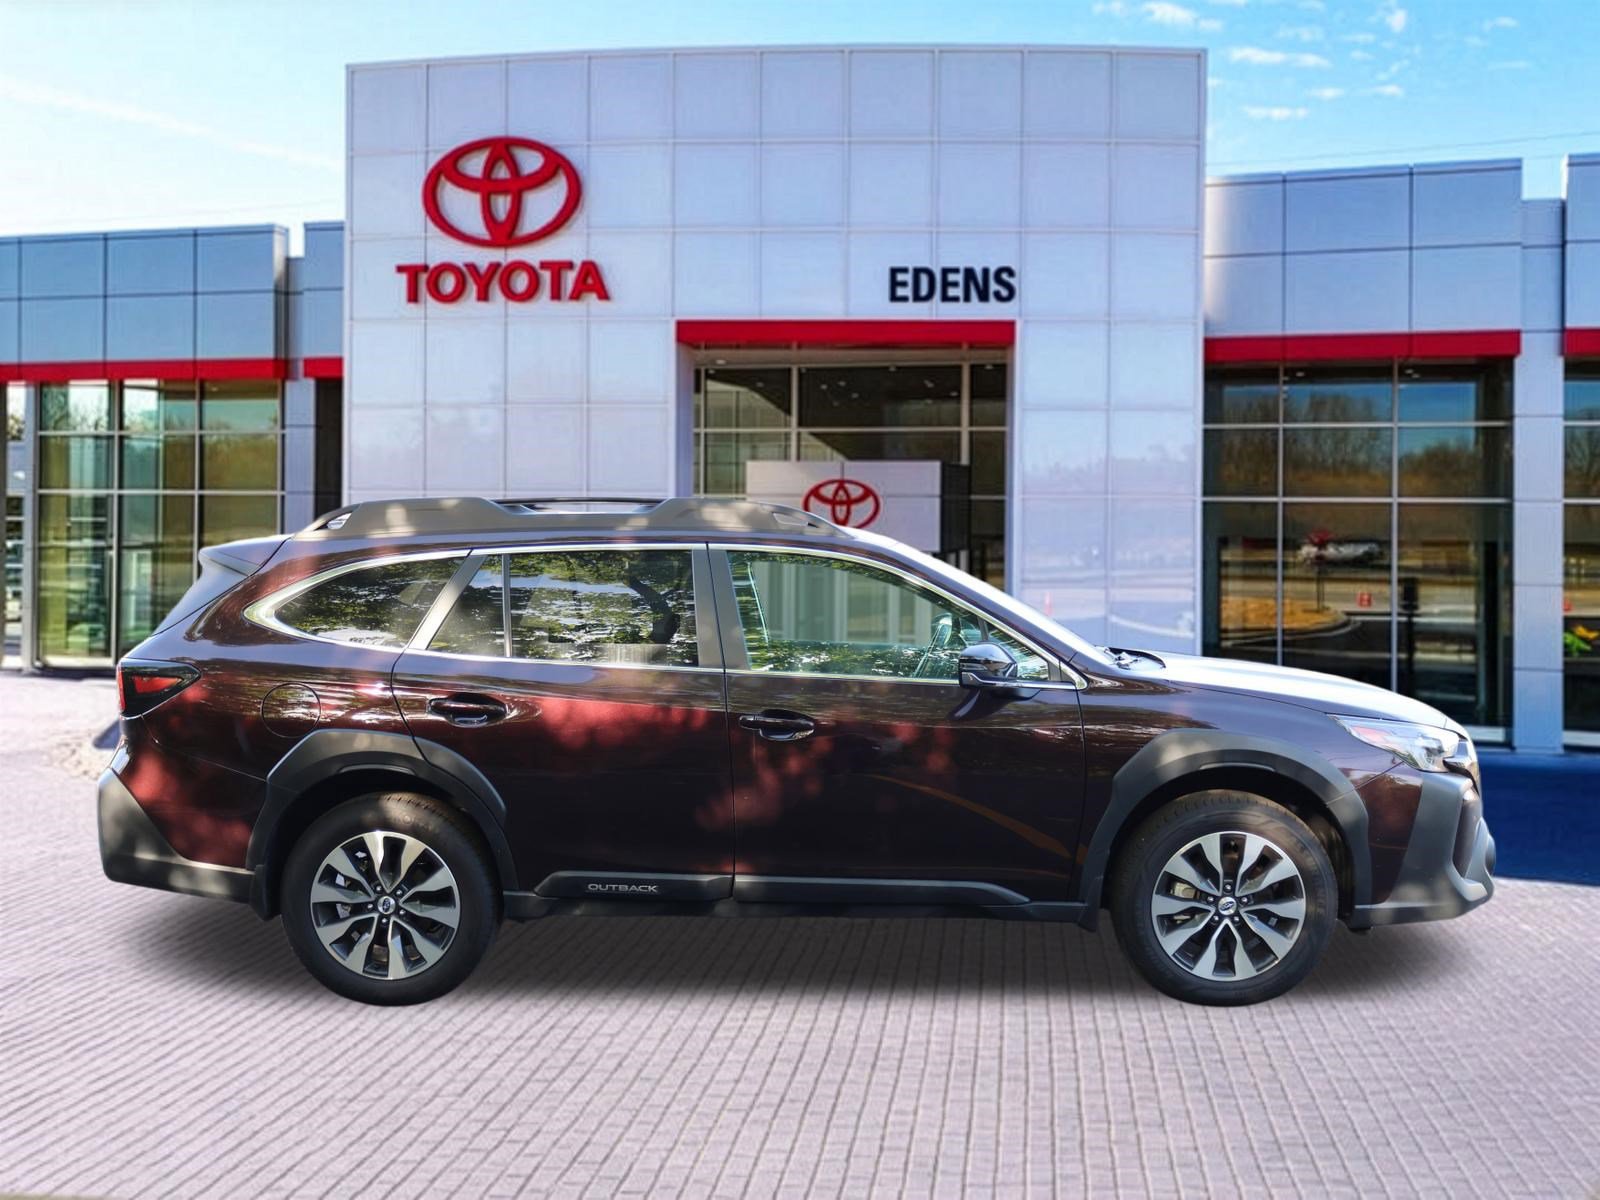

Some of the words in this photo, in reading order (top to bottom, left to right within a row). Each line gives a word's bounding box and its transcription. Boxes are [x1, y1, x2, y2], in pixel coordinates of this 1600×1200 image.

[396, 260, 610, 304] TOYOTA
[889, 266, 1017, 303] EDENS
[587, 883, 658, 893] OUTBACK
